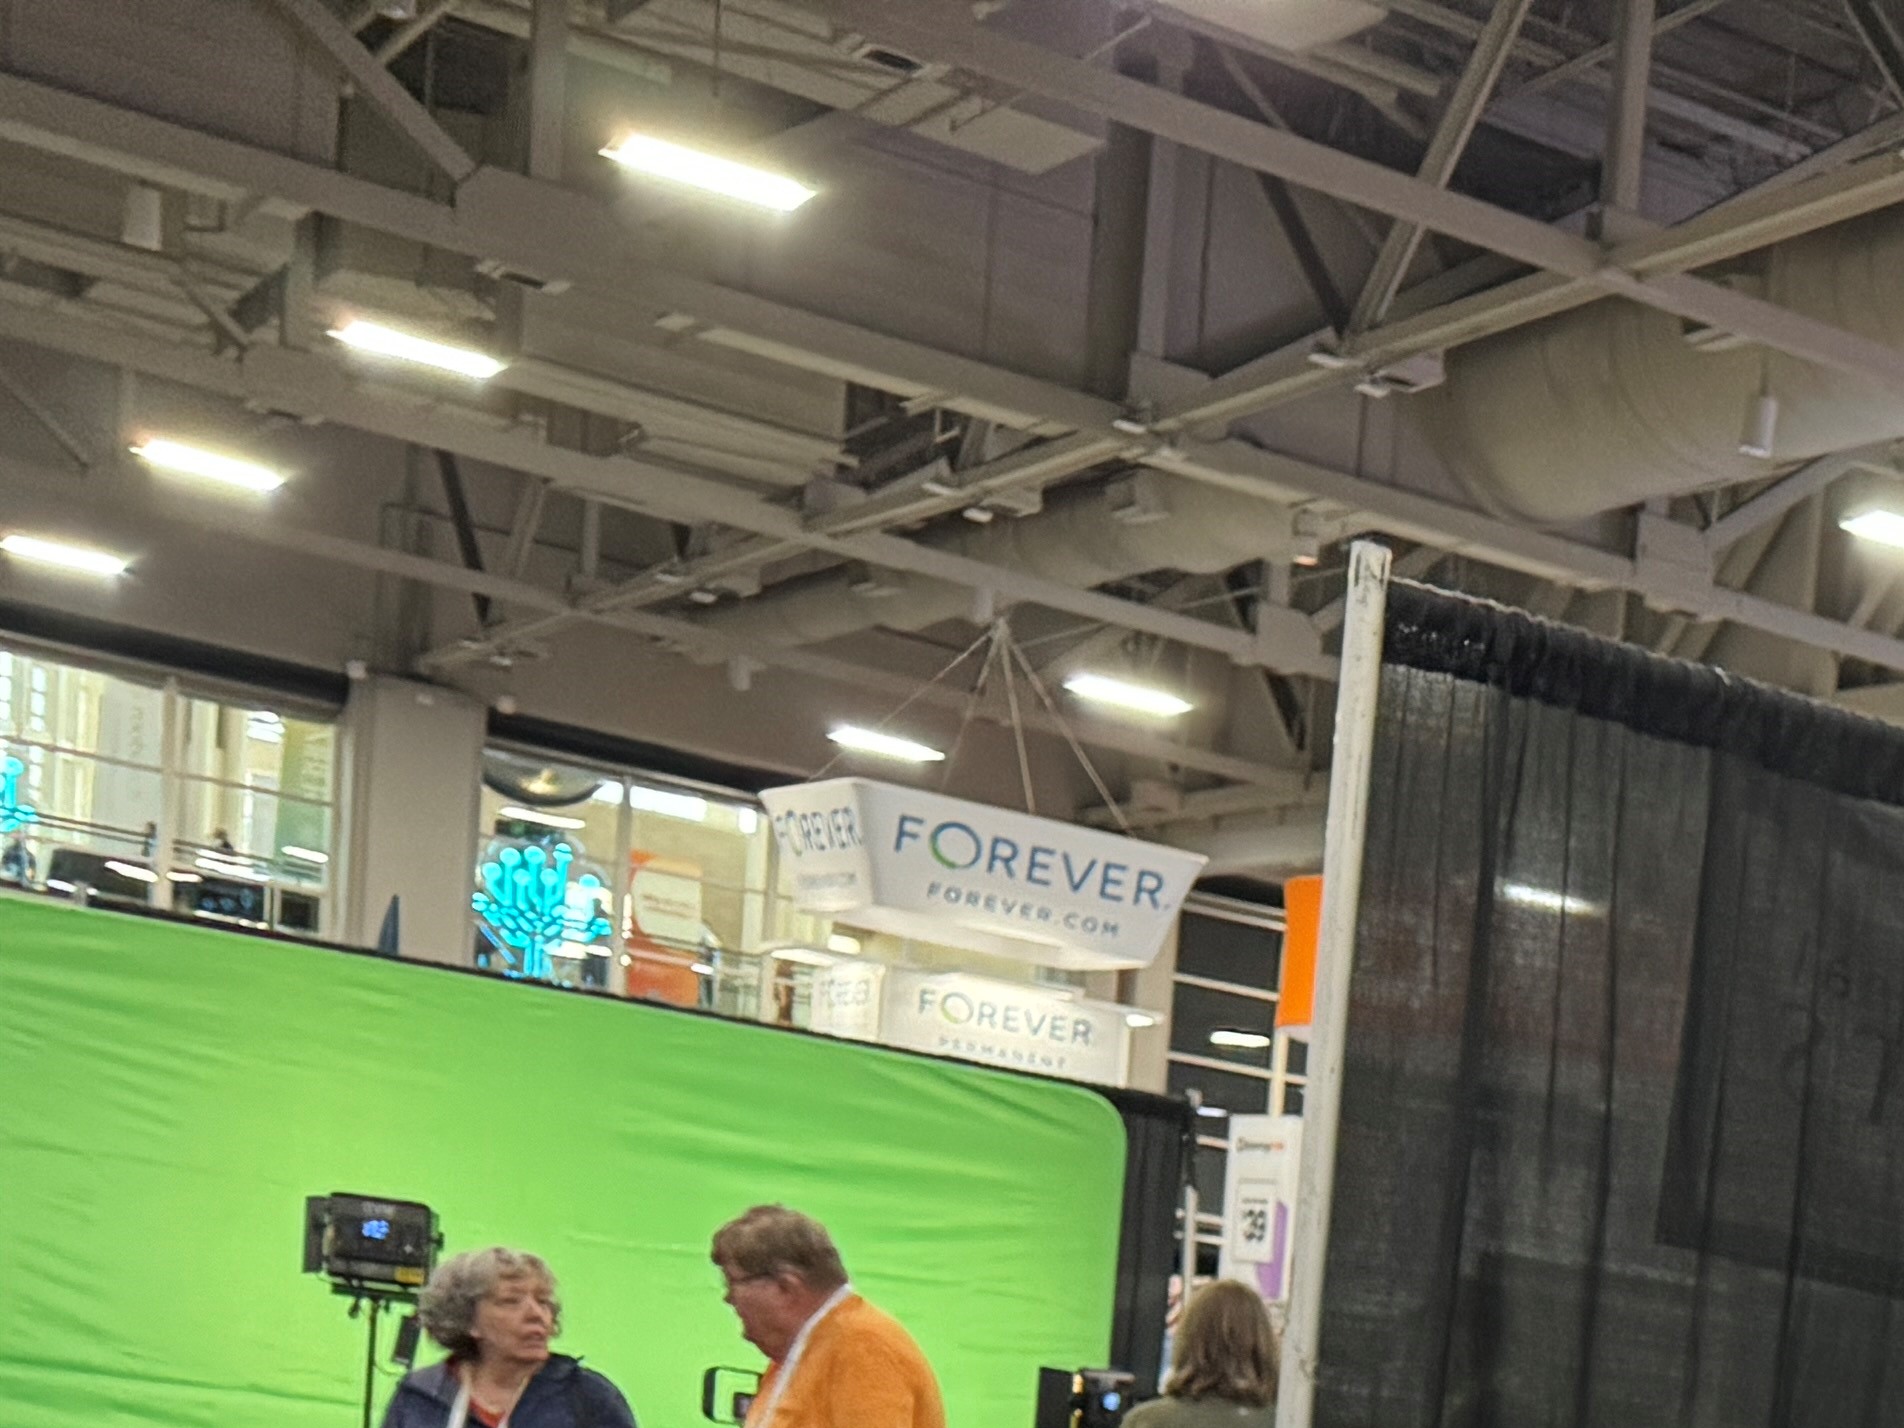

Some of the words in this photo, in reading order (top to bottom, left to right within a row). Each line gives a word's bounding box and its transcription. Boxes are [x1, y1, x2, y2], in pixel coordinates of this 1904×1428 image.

[893, 813, 1167, 911] FOREVER
[926, 881, 1120, 938] FOREVER.COM
[917, 988, 1095, 1047] FOREVER
